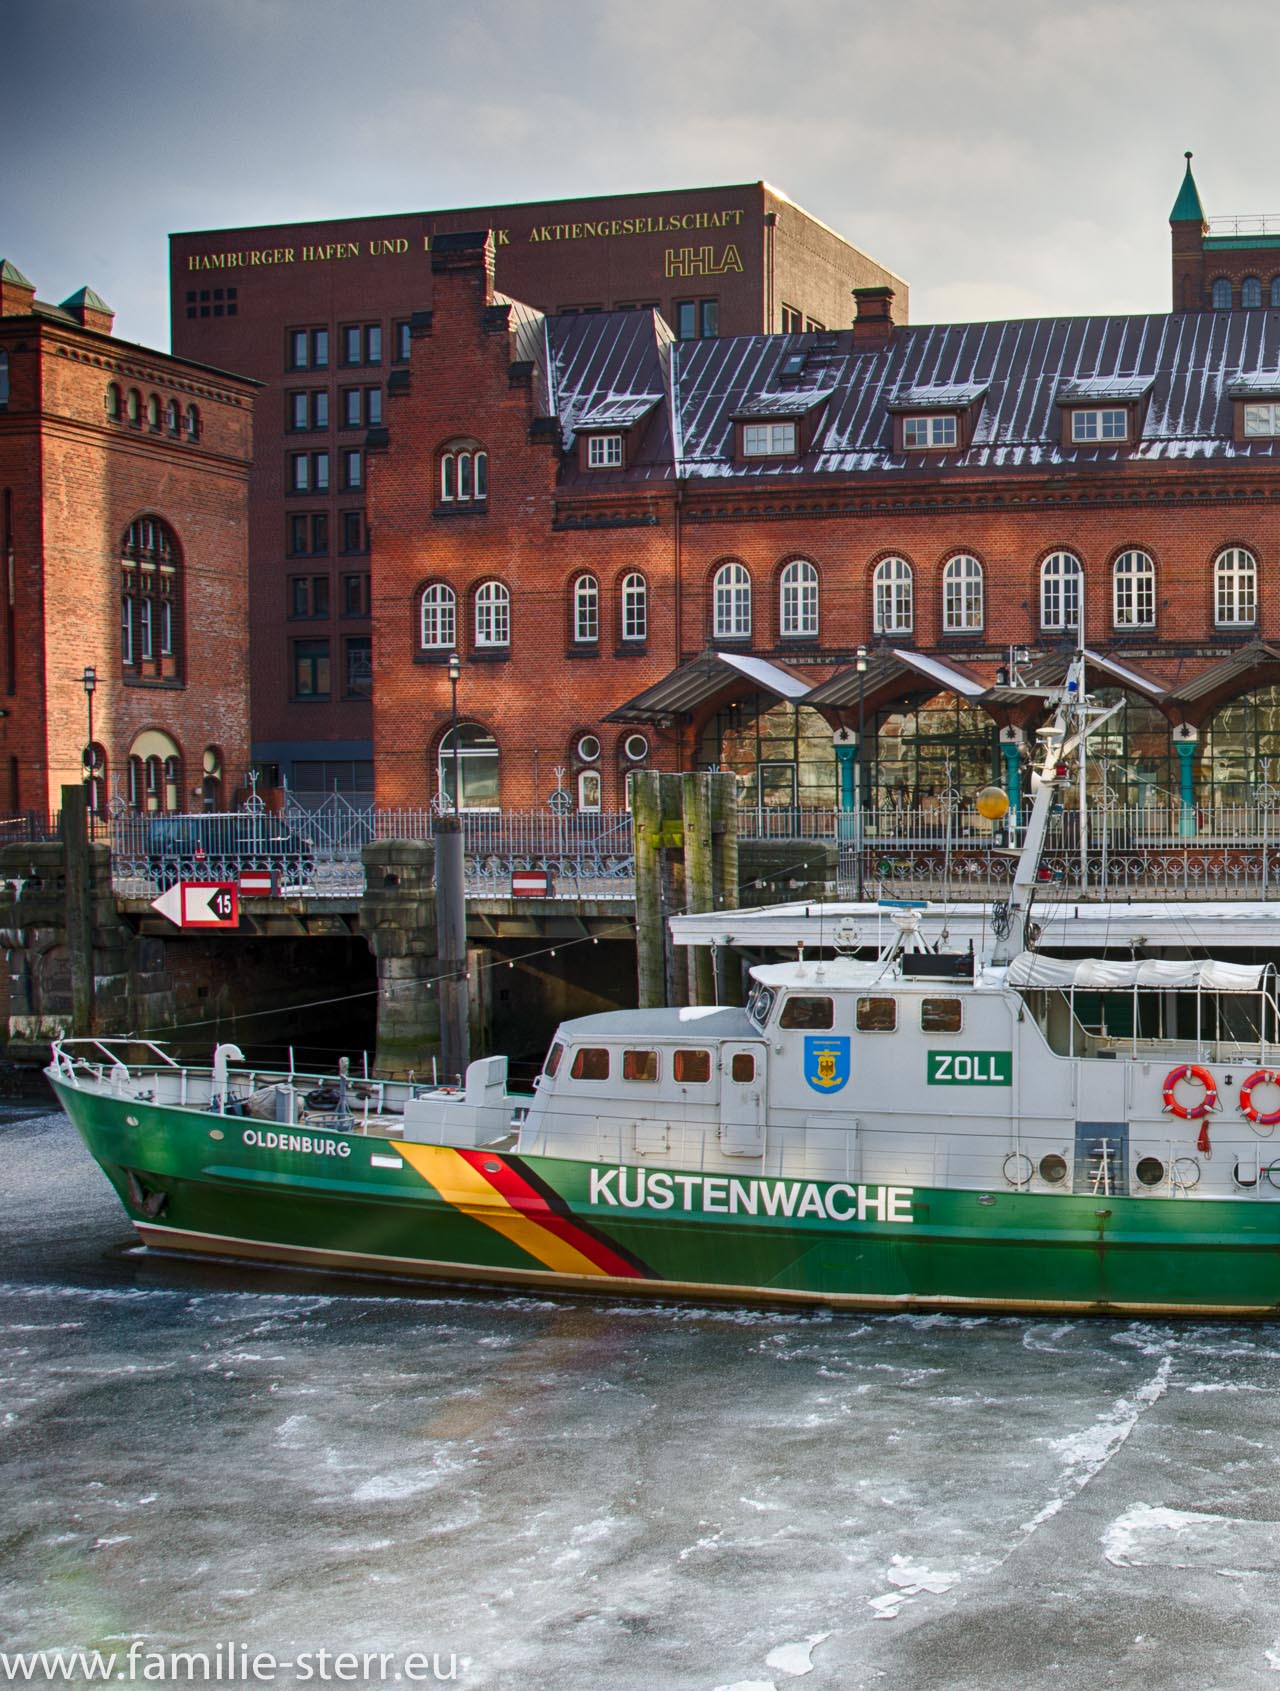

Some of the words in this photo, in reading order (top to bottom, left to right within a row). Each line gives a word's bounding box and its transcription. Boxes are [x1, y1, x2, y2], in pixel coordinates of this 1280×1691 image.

[188, 248, 294, 271] HAMBURGER
[303, 241, 360, 262] HAFEN
[370, 238, 409, 256] UND
[529, 210, 744, 243] AKTIENGESELLSCHAFT
[665, 244, 744, 278] HHLA
[216, 894, 233, 914] 15
[934, 1055, 1005, 1081] ZOLL
[242, 1129, 351, 1158] OLDENBURG
[589, 1166, 914, 1223] KÜSTENWACHE
